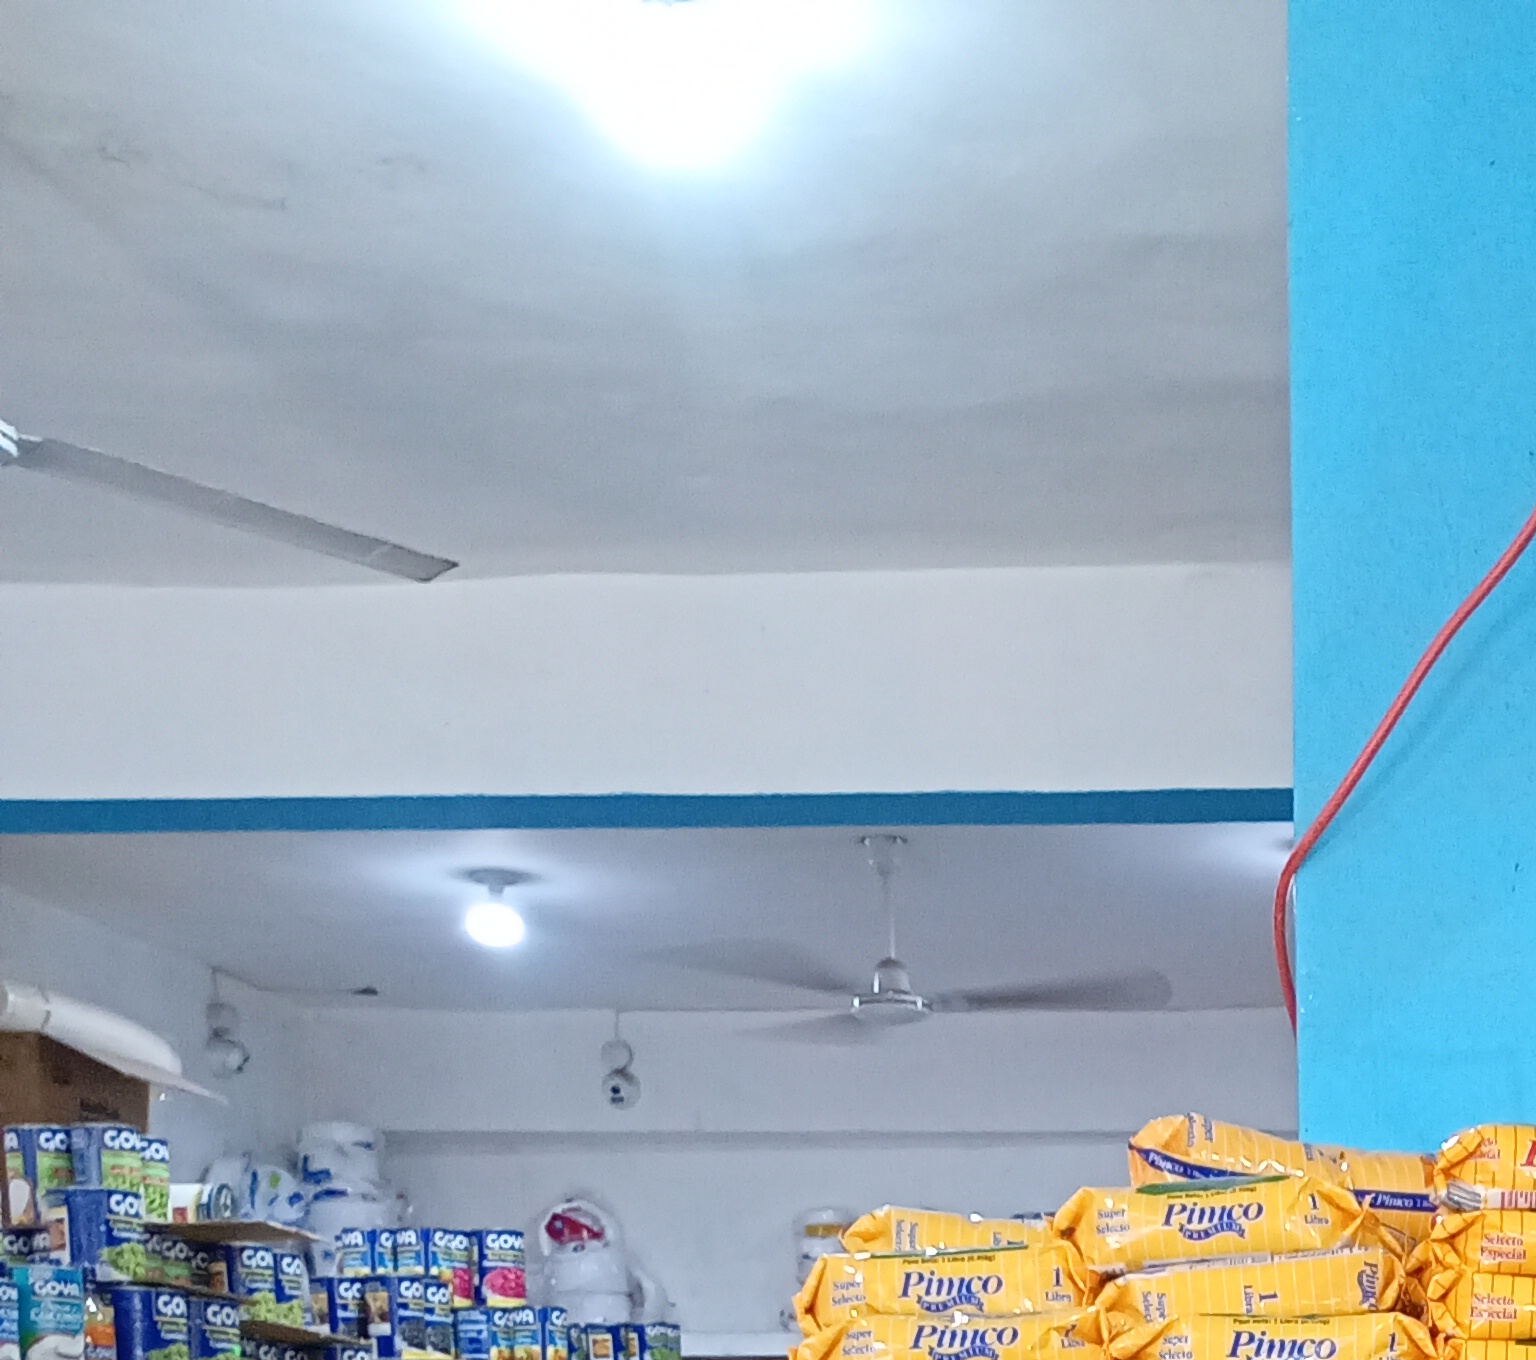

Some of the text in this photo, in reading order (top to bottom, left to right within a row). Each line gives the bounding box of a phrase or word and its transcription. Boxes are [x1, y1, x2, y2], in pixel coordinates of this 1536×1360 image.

[1163, 1199, 1264, 1228] Pimco
[1483, 1234, 1524, 1247] Selecto
[900, 1269, 1004, 1299] Pimco
[1226, 1331, 1337, 1360] Pimco
